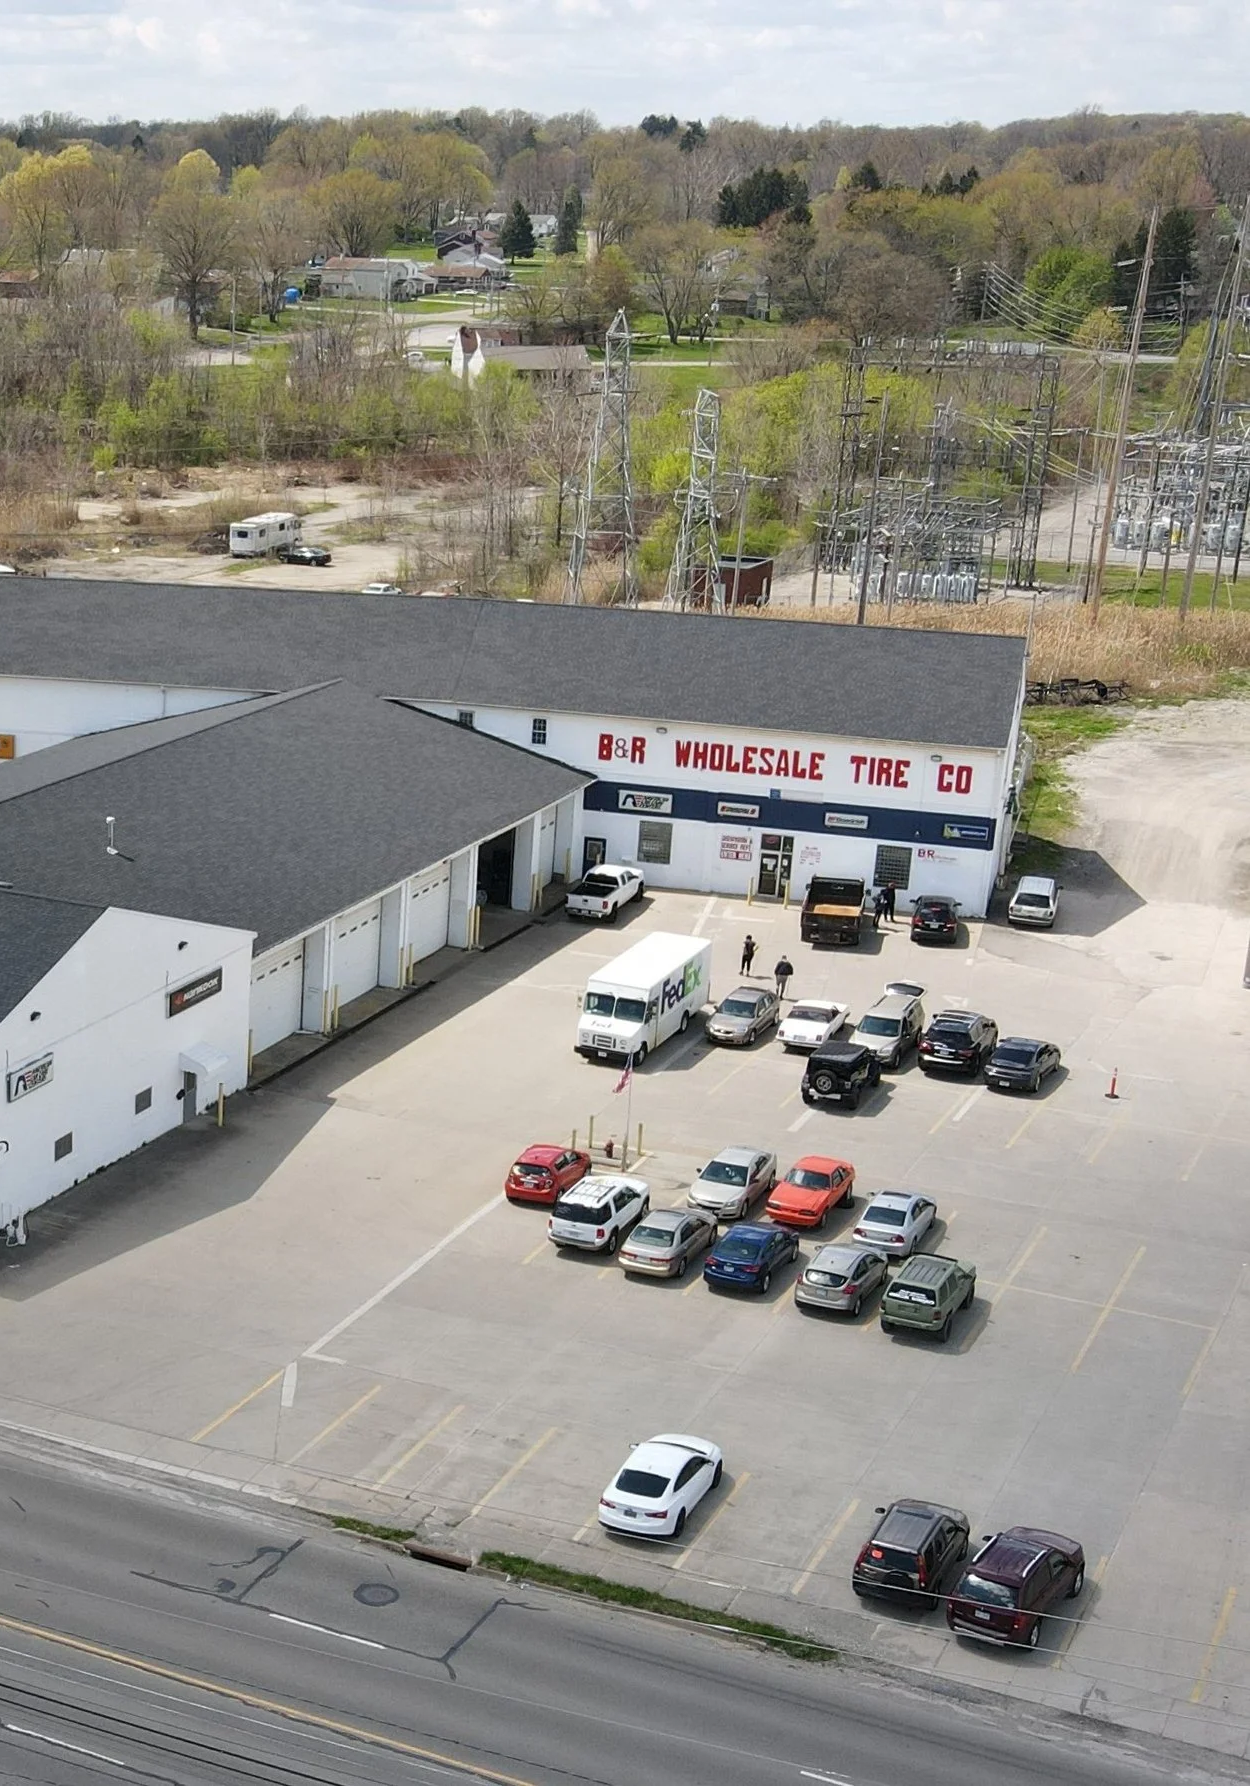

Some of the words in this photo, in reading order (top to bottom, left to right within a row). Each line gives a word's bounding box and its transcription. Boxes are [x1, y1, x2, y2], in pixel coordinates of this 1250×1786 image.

[598, 733, 646, 764] B&R
[675, 740, 825, 780] WHOLESALE
[850, 755, 911, 788] TIRE
[937, 764, 973, 794] CO
[661, 960, 702, 1014] FedEx
